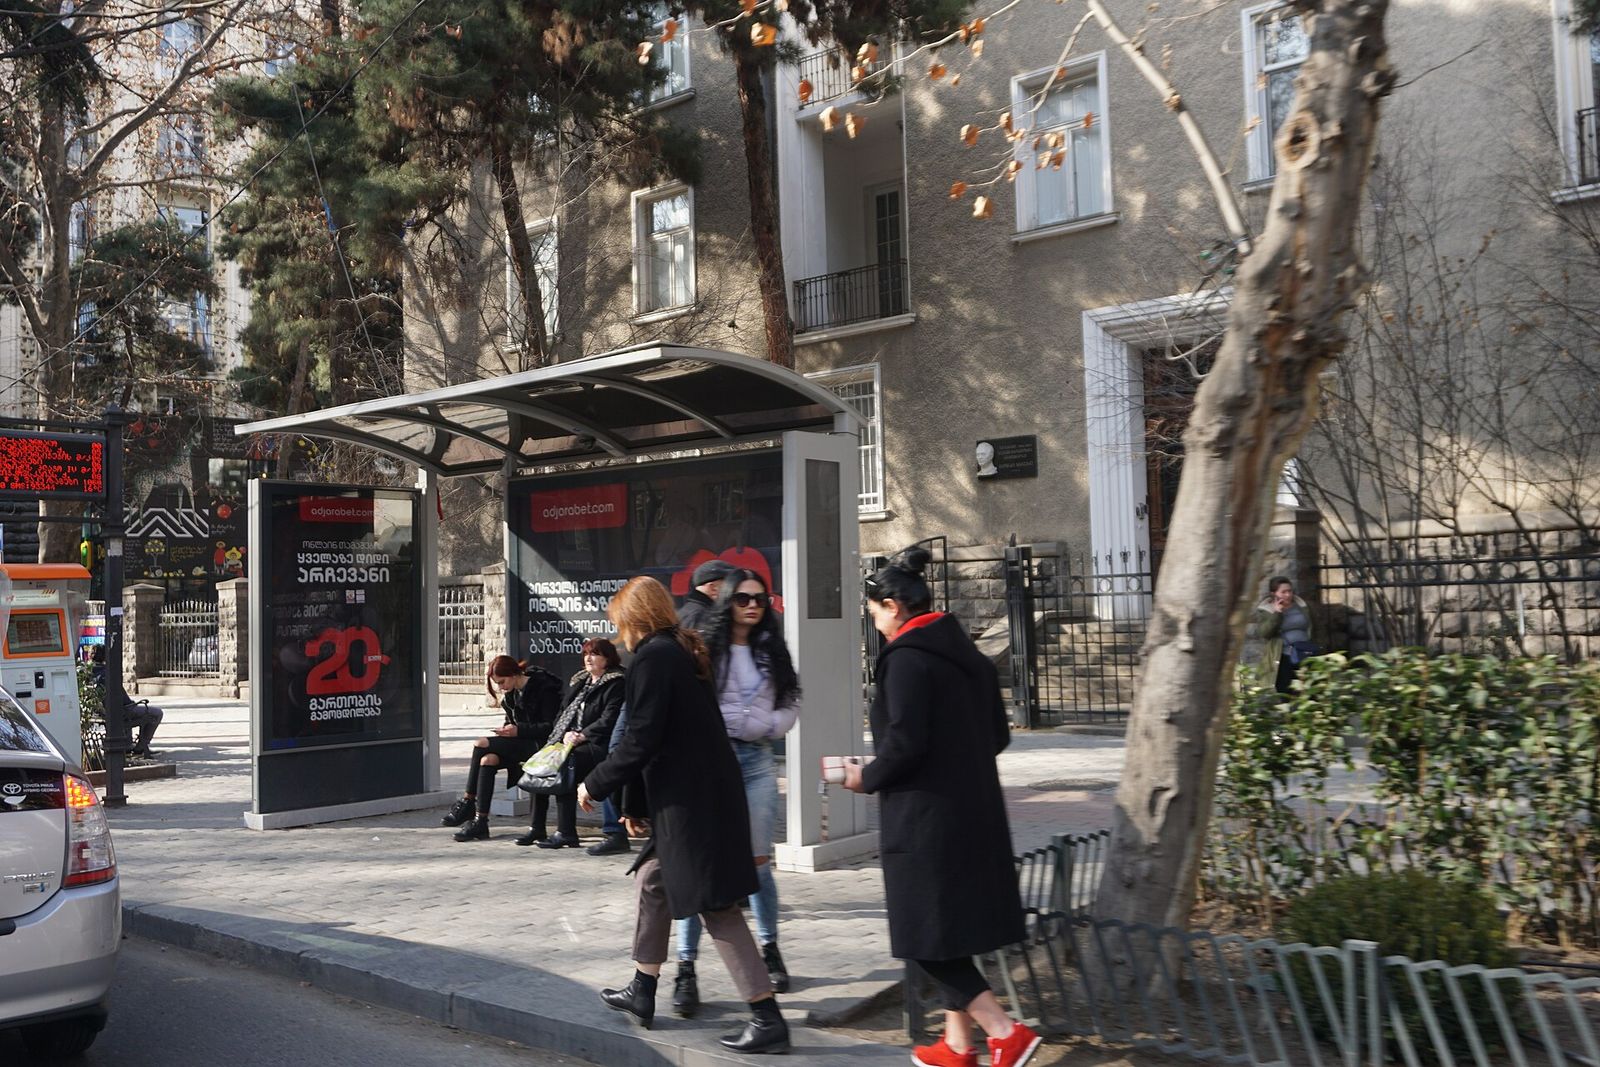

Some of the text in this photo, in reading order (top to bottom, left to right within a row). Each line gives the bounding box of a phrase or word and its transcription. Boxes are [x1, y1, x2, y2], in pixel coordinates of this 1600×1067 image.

[543, 502, 614, 519] adjarabet.com
[297, 553, 390, 564] ყველაზე დიდი
[297, 567, 390, 583] არჩევანი
[580, 579, 628, 593] ქართულ
[528, 597, 583, 613] ონლაინ
[529, 619, 618, 634] საერთაშორის
[529, 637, 592, 654] ბაზარზ
[305, 625, 381, 694] 20
[309, 694, 382, 711] გართობის
[310, 707, 381, 721] გამოცდილება
